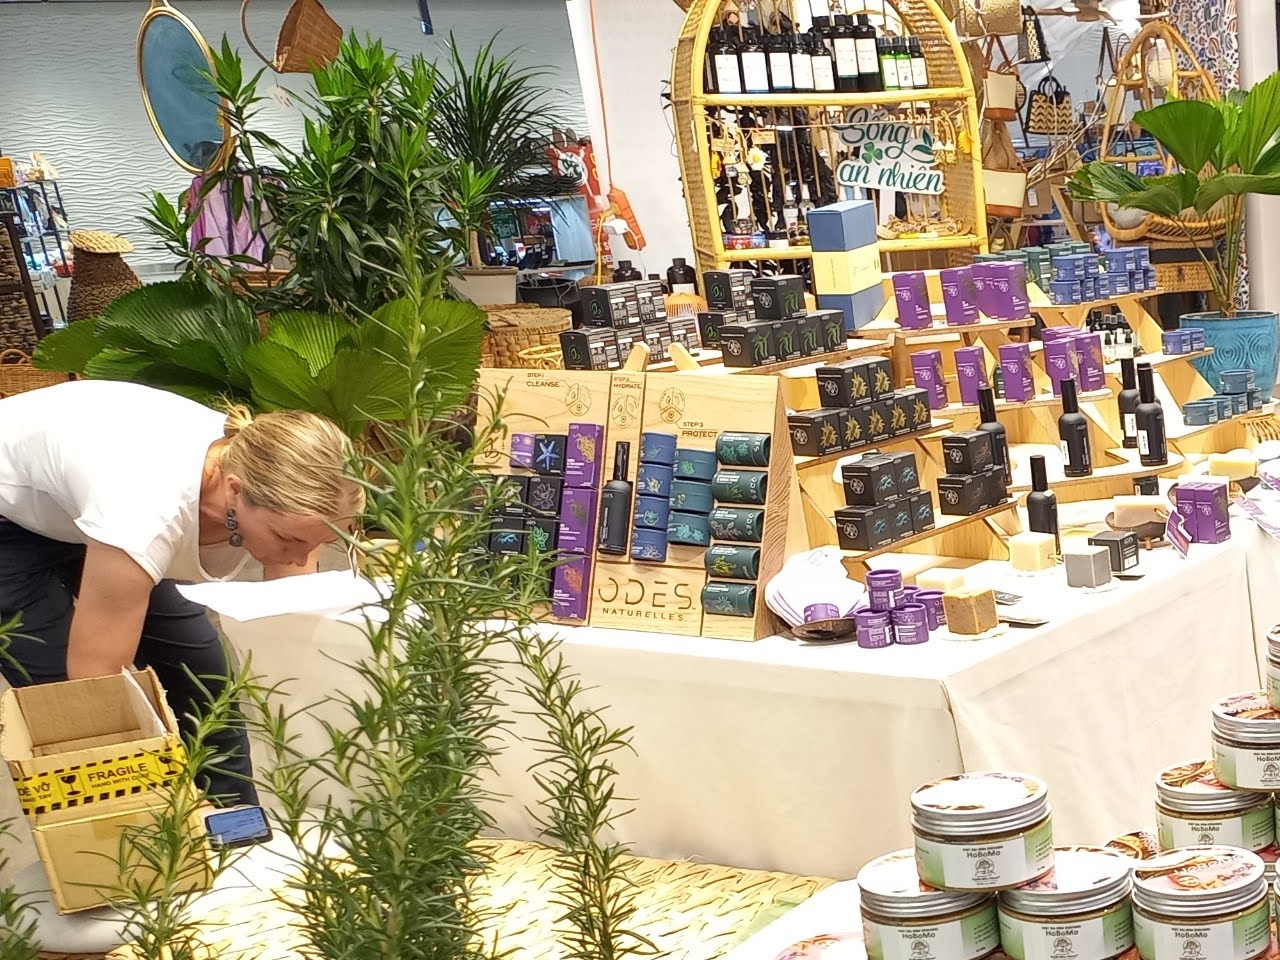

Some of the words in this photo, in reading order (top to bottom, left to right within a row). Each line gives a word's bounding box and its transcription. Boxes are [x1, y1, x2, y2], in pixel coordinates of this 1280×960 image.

[840, 163, 870, 184] an
[878, 162, 942, 192] nhiên
[526, 380, 560, 388] CLEANSE
[682, 430, 718, 438] PROTECT
[602, 608, 684, 622] NATURELLES
[87, 762, 148, 782] FRAGILE
[966, 850, 1001, 858] HoBoMo
[902, 932, 936, 940] HoBoMo
[1046, 928, 1079, 938] HoBoMo
[1174, 930, 1208, 939] HoBoMo
